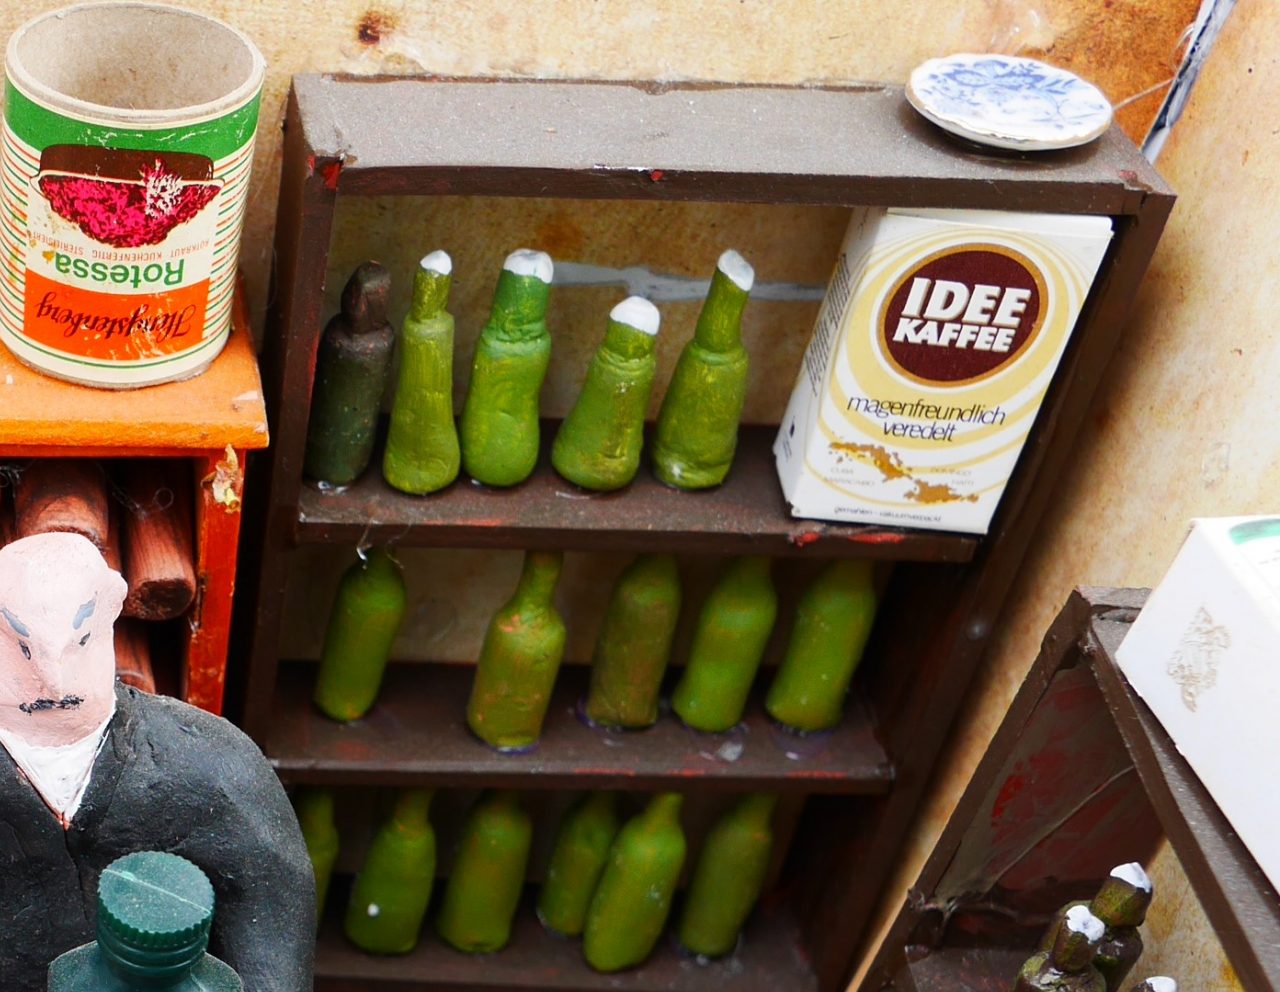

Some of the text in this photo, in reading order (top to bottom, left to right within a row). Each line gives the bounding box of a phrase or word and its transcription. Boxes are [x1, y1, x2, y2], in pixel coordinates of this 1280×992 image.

[55, 253, 185, 288] Rotessa
[901, 277, 1032, 328] IDEE
[893, 318, 1017, 352] KAFFEE
[847, 396, 1007, 426] magenfreundlich
[883, 420, 956, 442] veredelt
